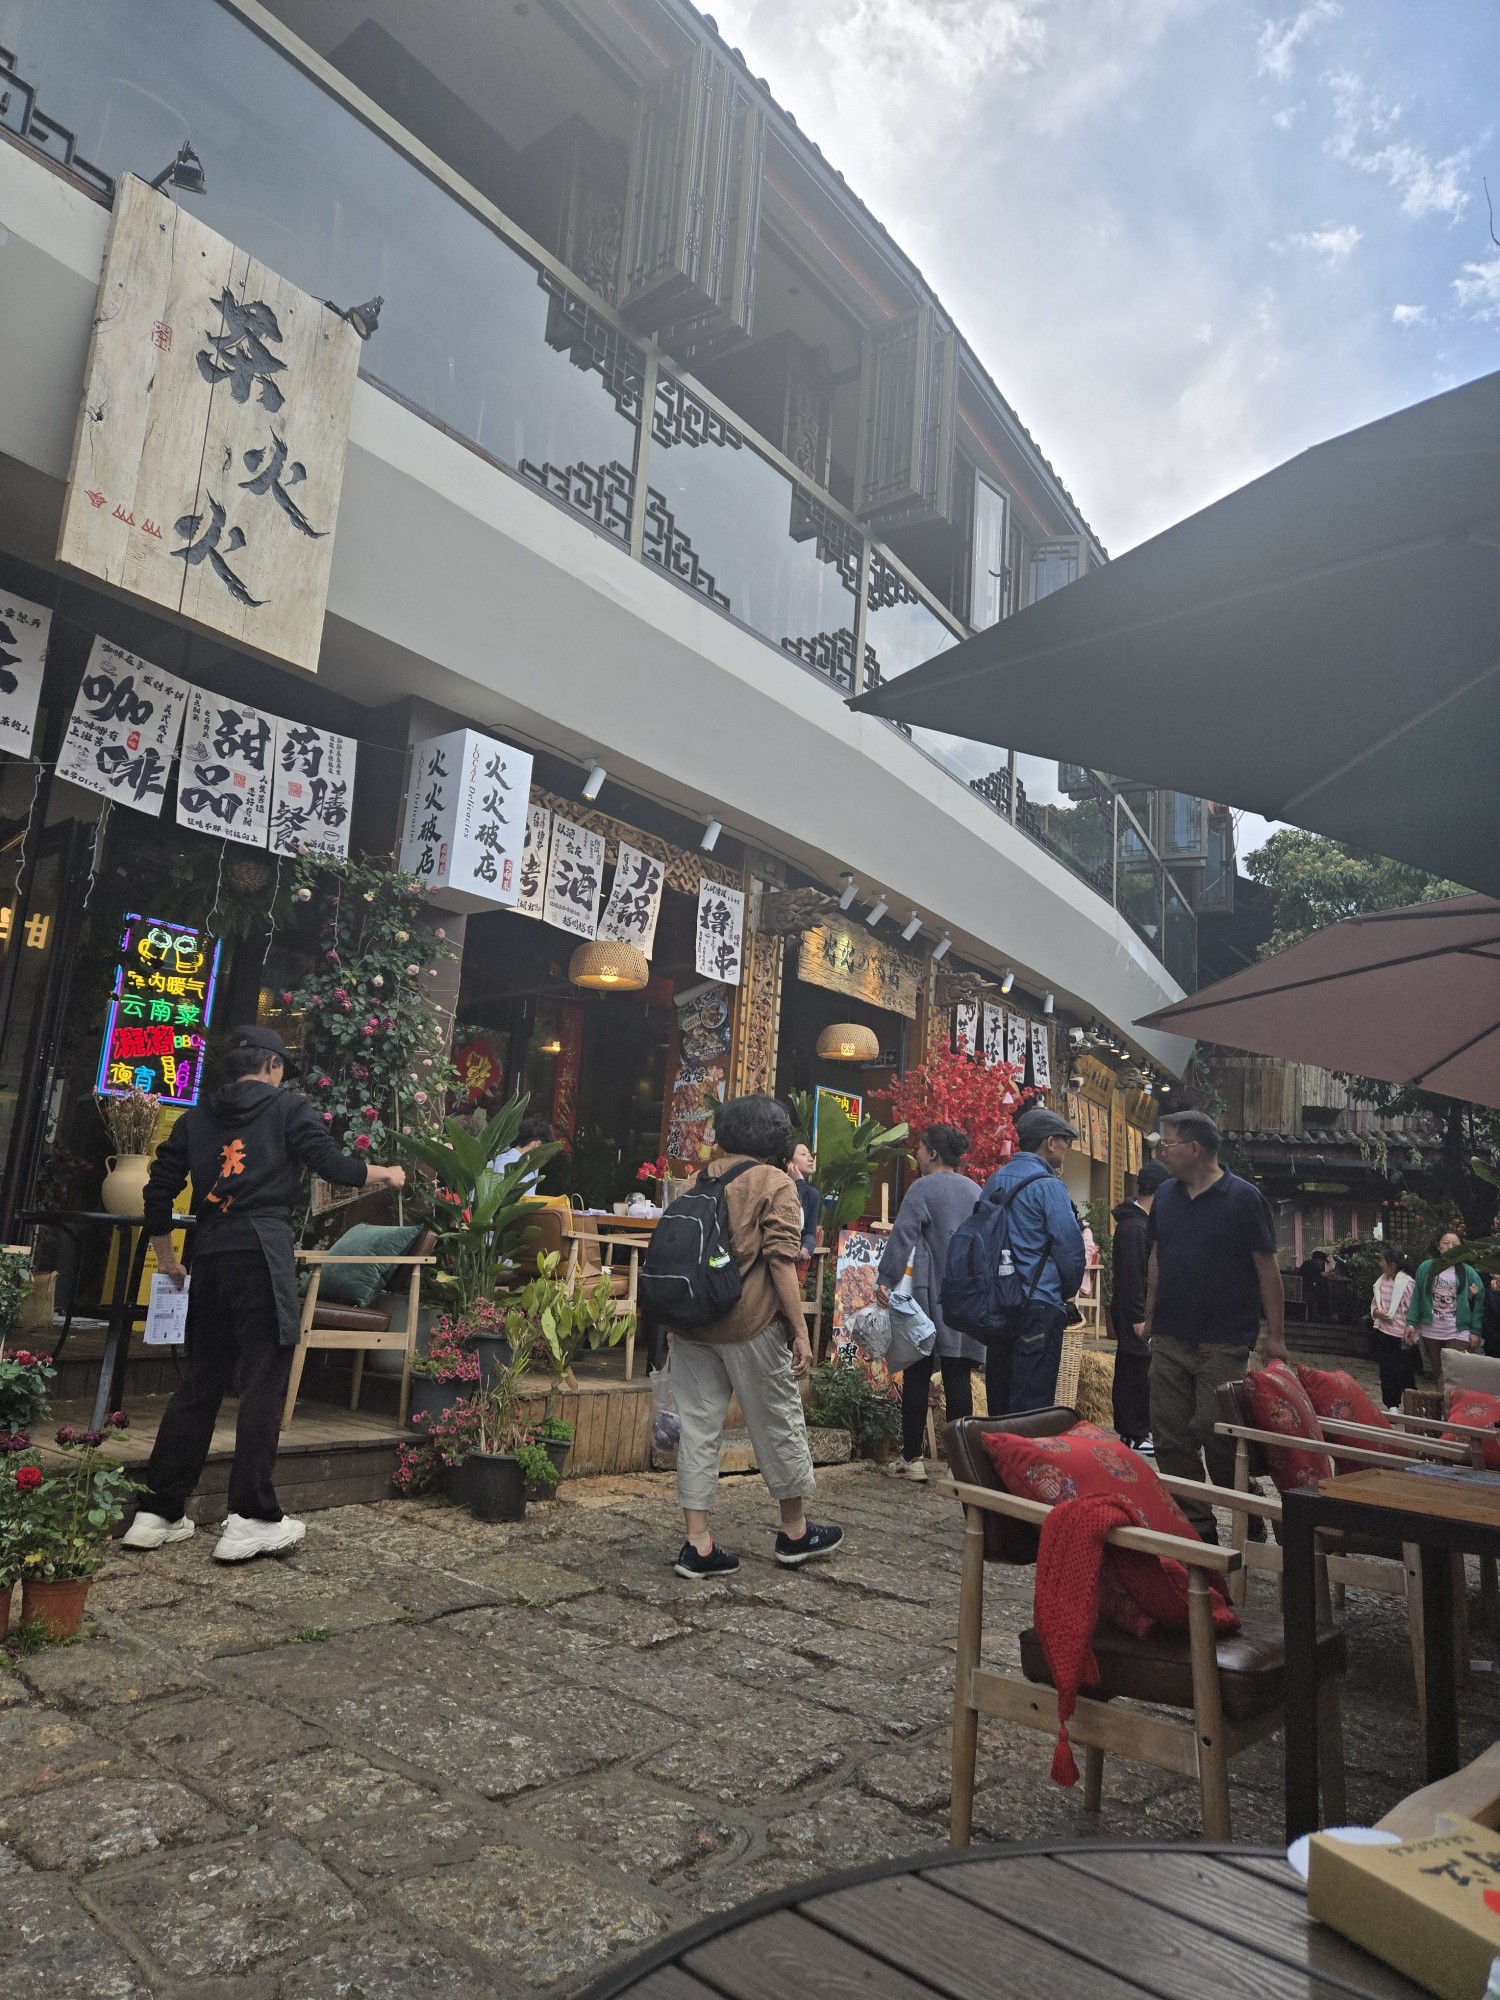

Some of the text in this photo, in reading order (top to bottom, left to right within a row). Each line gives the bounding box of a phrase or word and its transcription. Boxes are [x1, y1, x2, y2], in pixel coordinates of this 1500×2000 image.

[82, 674, 166, 802] 咖啡
[179, 708, 271, 824] 甜品
[415, 748, 450, 876] 火火破店
[463, 743, 480, 839] LOCAL Delicacies
[474, 750, 515, 883] 火火破店
[555, 860, 598, 911] 酒
[616, 856, 660, 935] 火锅
[700, 900, 738, 979] 撸串
[121, 994, 200, 1027] 云南菜
